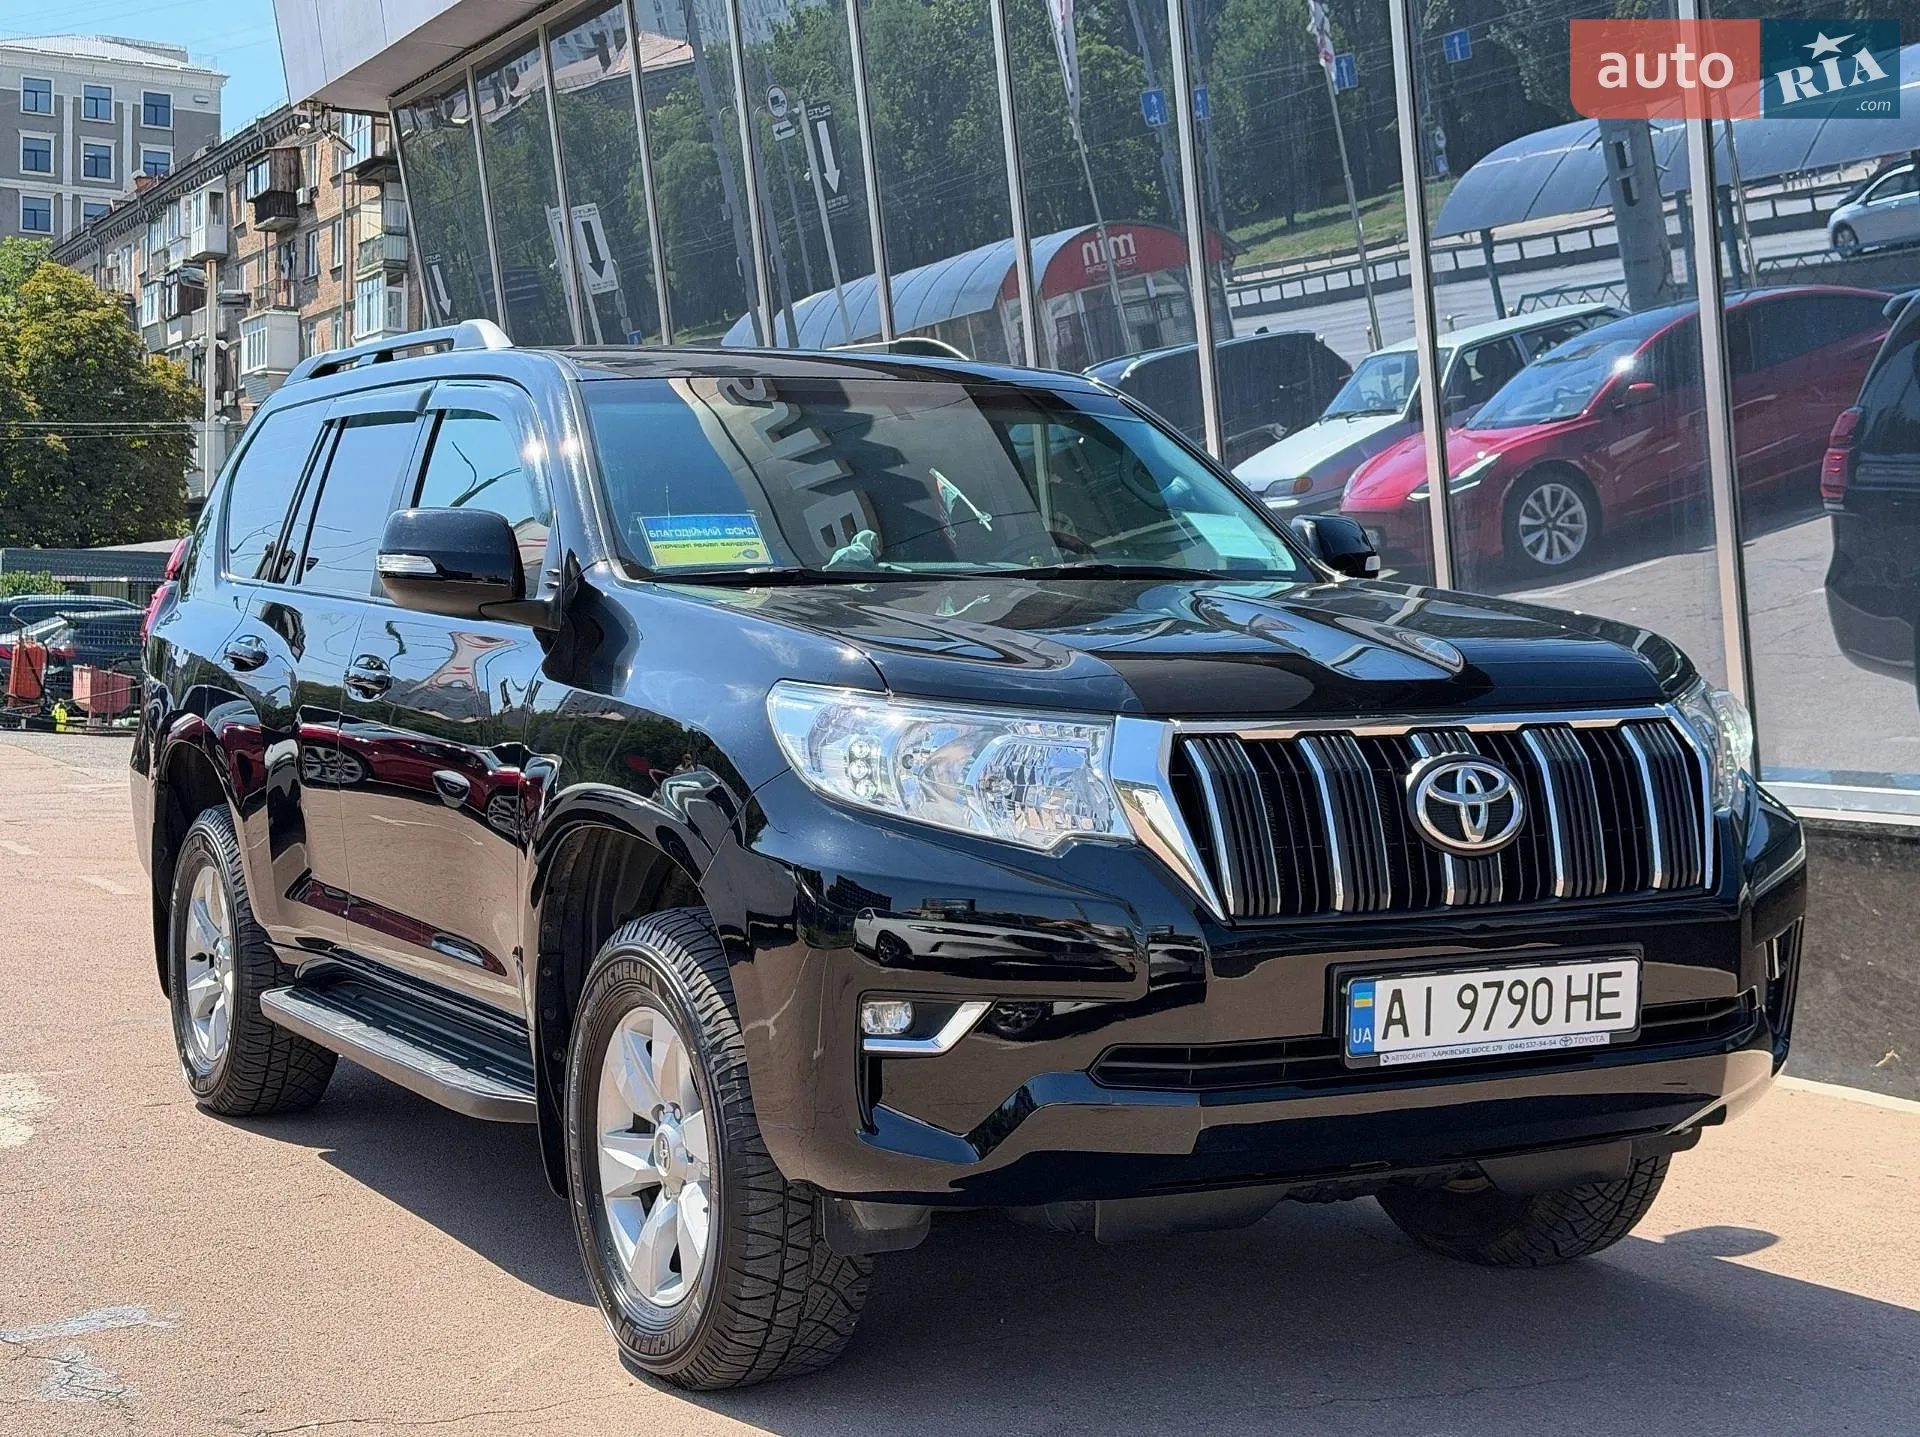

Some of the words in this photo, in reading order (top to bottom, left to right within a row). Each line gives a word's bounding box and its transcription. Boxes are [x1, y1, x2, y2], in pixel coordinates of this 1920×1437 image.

[725, 526, 755, 536] ФОНД
[593, 961, 652, 1003] MICHELIN
[1457, 977, 1554, 1034] 9790
[1565, 971, 1622, 1024] HE
[1352, 1027, 1372, 1044] UA
[1573, 1035, 1605, 1045] TOYOTA
[620, 1321, 686, 1355] MICHELIN
